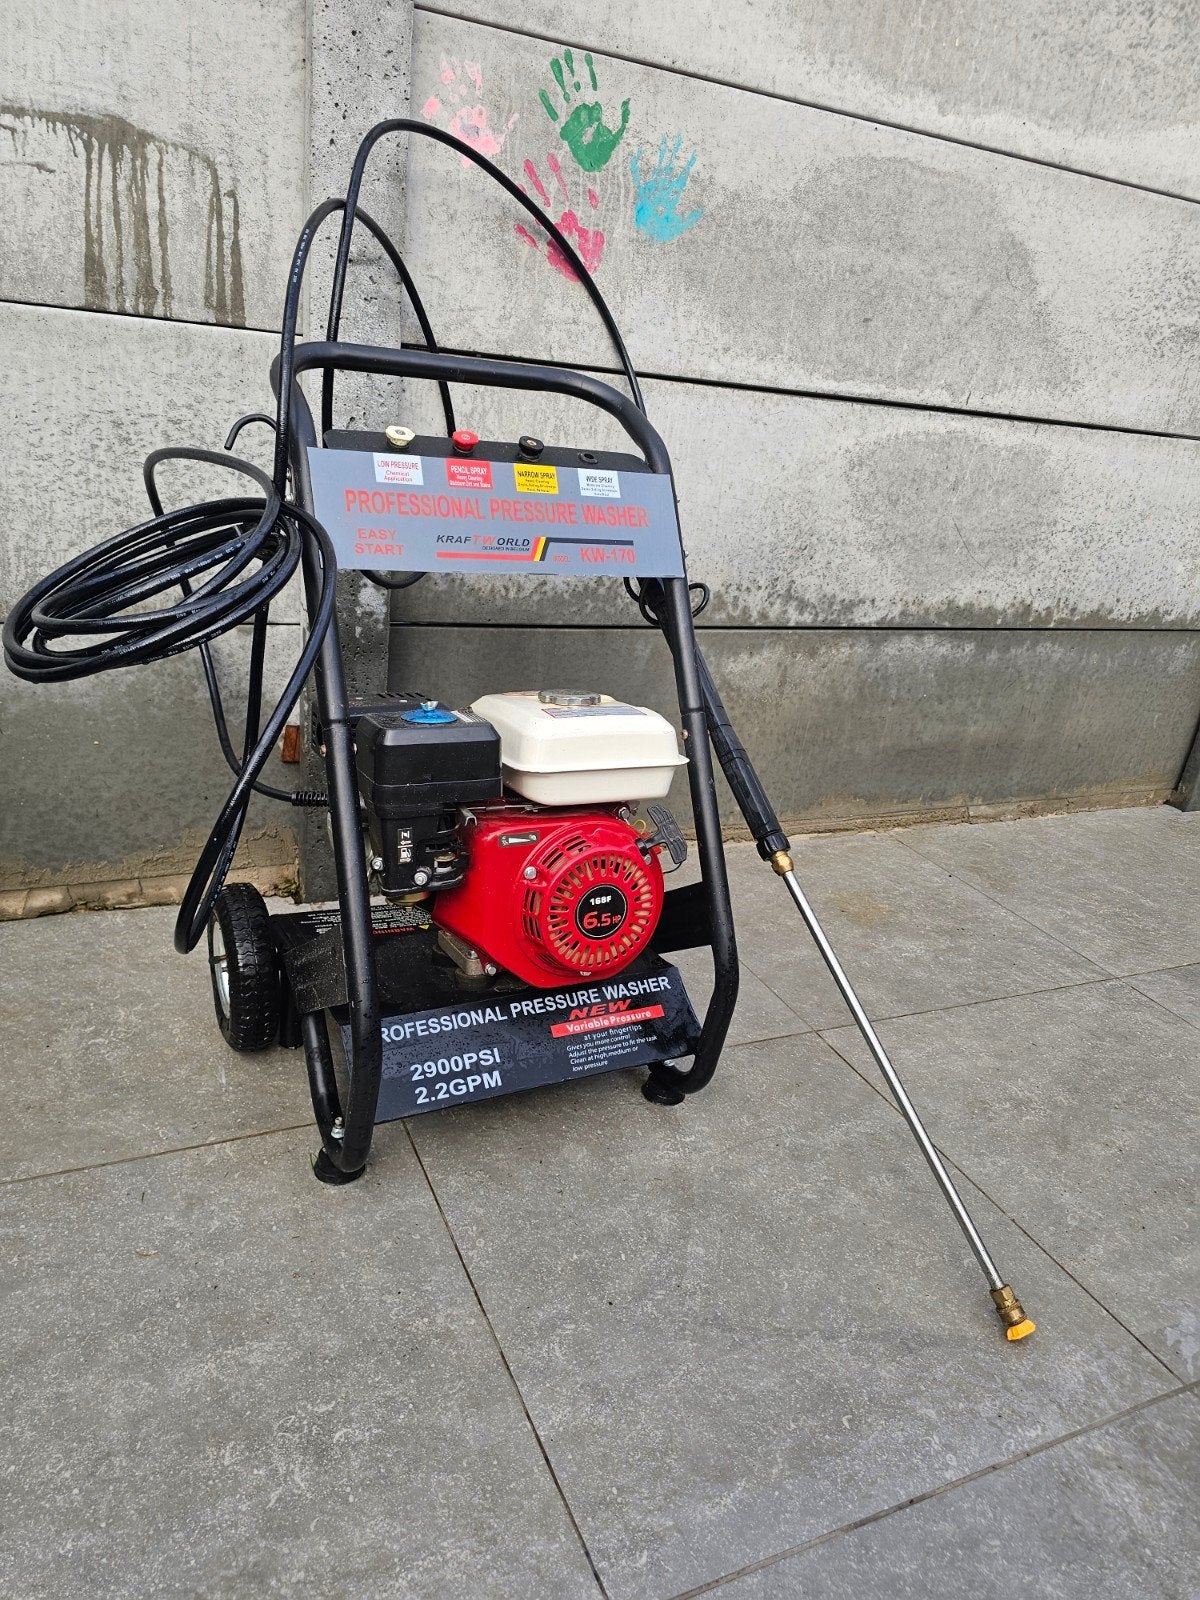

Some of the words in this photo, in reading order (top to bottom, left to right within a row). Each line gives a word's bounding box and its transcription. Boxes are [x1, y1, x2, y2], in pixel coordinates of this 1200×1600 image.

[391, 461, 420, 470] PRESSURE
[451, 466, 470, 474] PENCIL
[344, 490, 486, 520] PROFESSIONAL
[489, 498, 579, 525] PRESSURE
[581, 504, 649, 527] WASHER
[358, 528, 397, 540] EASY
[436, 534, 530, 546] KRAFTWORLD
[355, 543, 404, 556] START
[580, 546, 635, 564] KW-170
[590, 896, 612, 905] 168F
[381, 1006, 508, 1042] ROFESSIONAL
[510, 988, 600, 1018] PRESSURE
[602, 976, 672, 1000] WASHER
[568, 999, 632, 1020] NEW
[566, 1016, 609, 1033] Variable
[610, 1010, 652, 1024] Pressure
[592, 1032, 608, 1040] your
[609, 1024, 642, 1036] fingertips
[598, 1043, 622, 1054] pressure
[410, 1047, 501, 1081] 2900PSI
[584, 1060, 608, 1070] pressure
[415, 1070, 503, 1104] 2.2GPM
